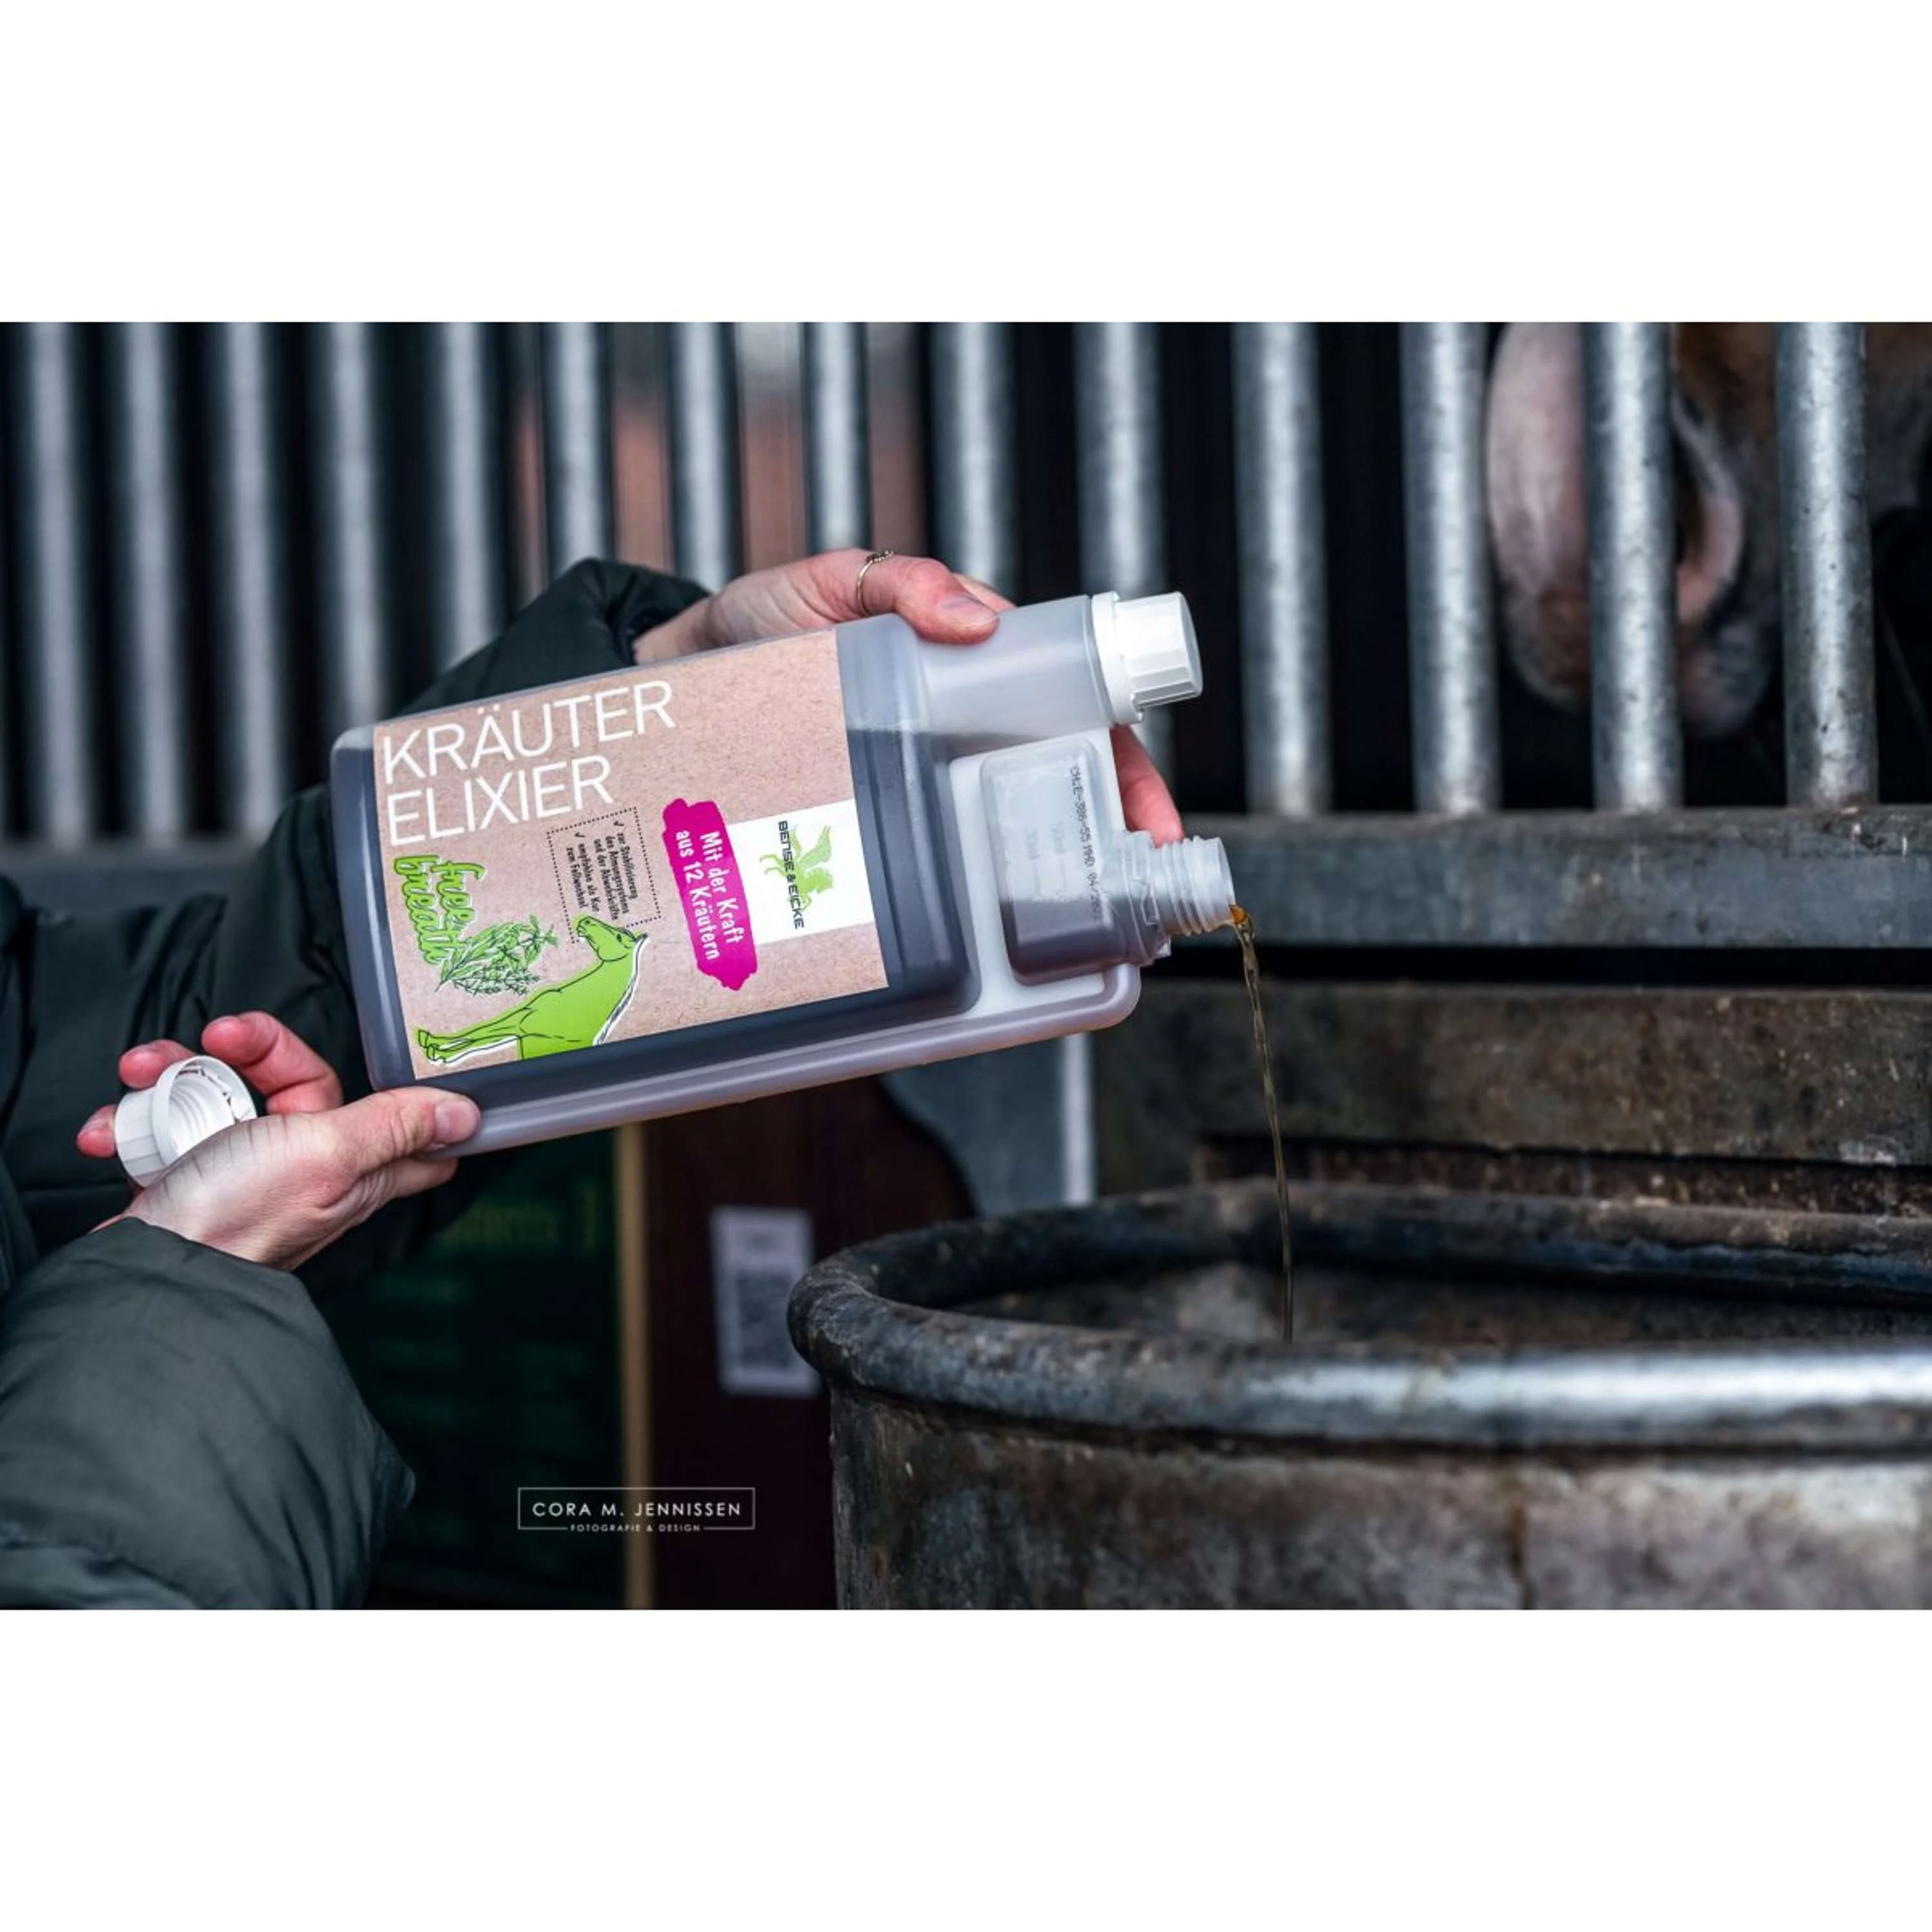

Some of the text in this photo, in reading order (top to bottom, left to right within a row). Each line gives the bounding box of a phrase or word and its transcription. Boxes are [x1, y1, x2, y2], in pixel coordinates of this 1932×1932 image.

[382, 680, 676, 784] KRÄUTER
[388, 755, 614, 846] ELIXIER
[567, 847, 589, 908] zum Fellwechsel
[578, 843, 601, 912] empfohlen als Kur
[594, 838, 620, 920] und der Abwehrkräfte
[605, 836, 616, 848] des
[617, 833, 638, 900] zur Stabilisierung
[778, 820, 804, 929] BENSE & EICKE
[430, 860, 486, 925] free
[676, 830, 720, 960] aus 12 Kräutern
[700, 831, 745, 944] Mit der Kraft
